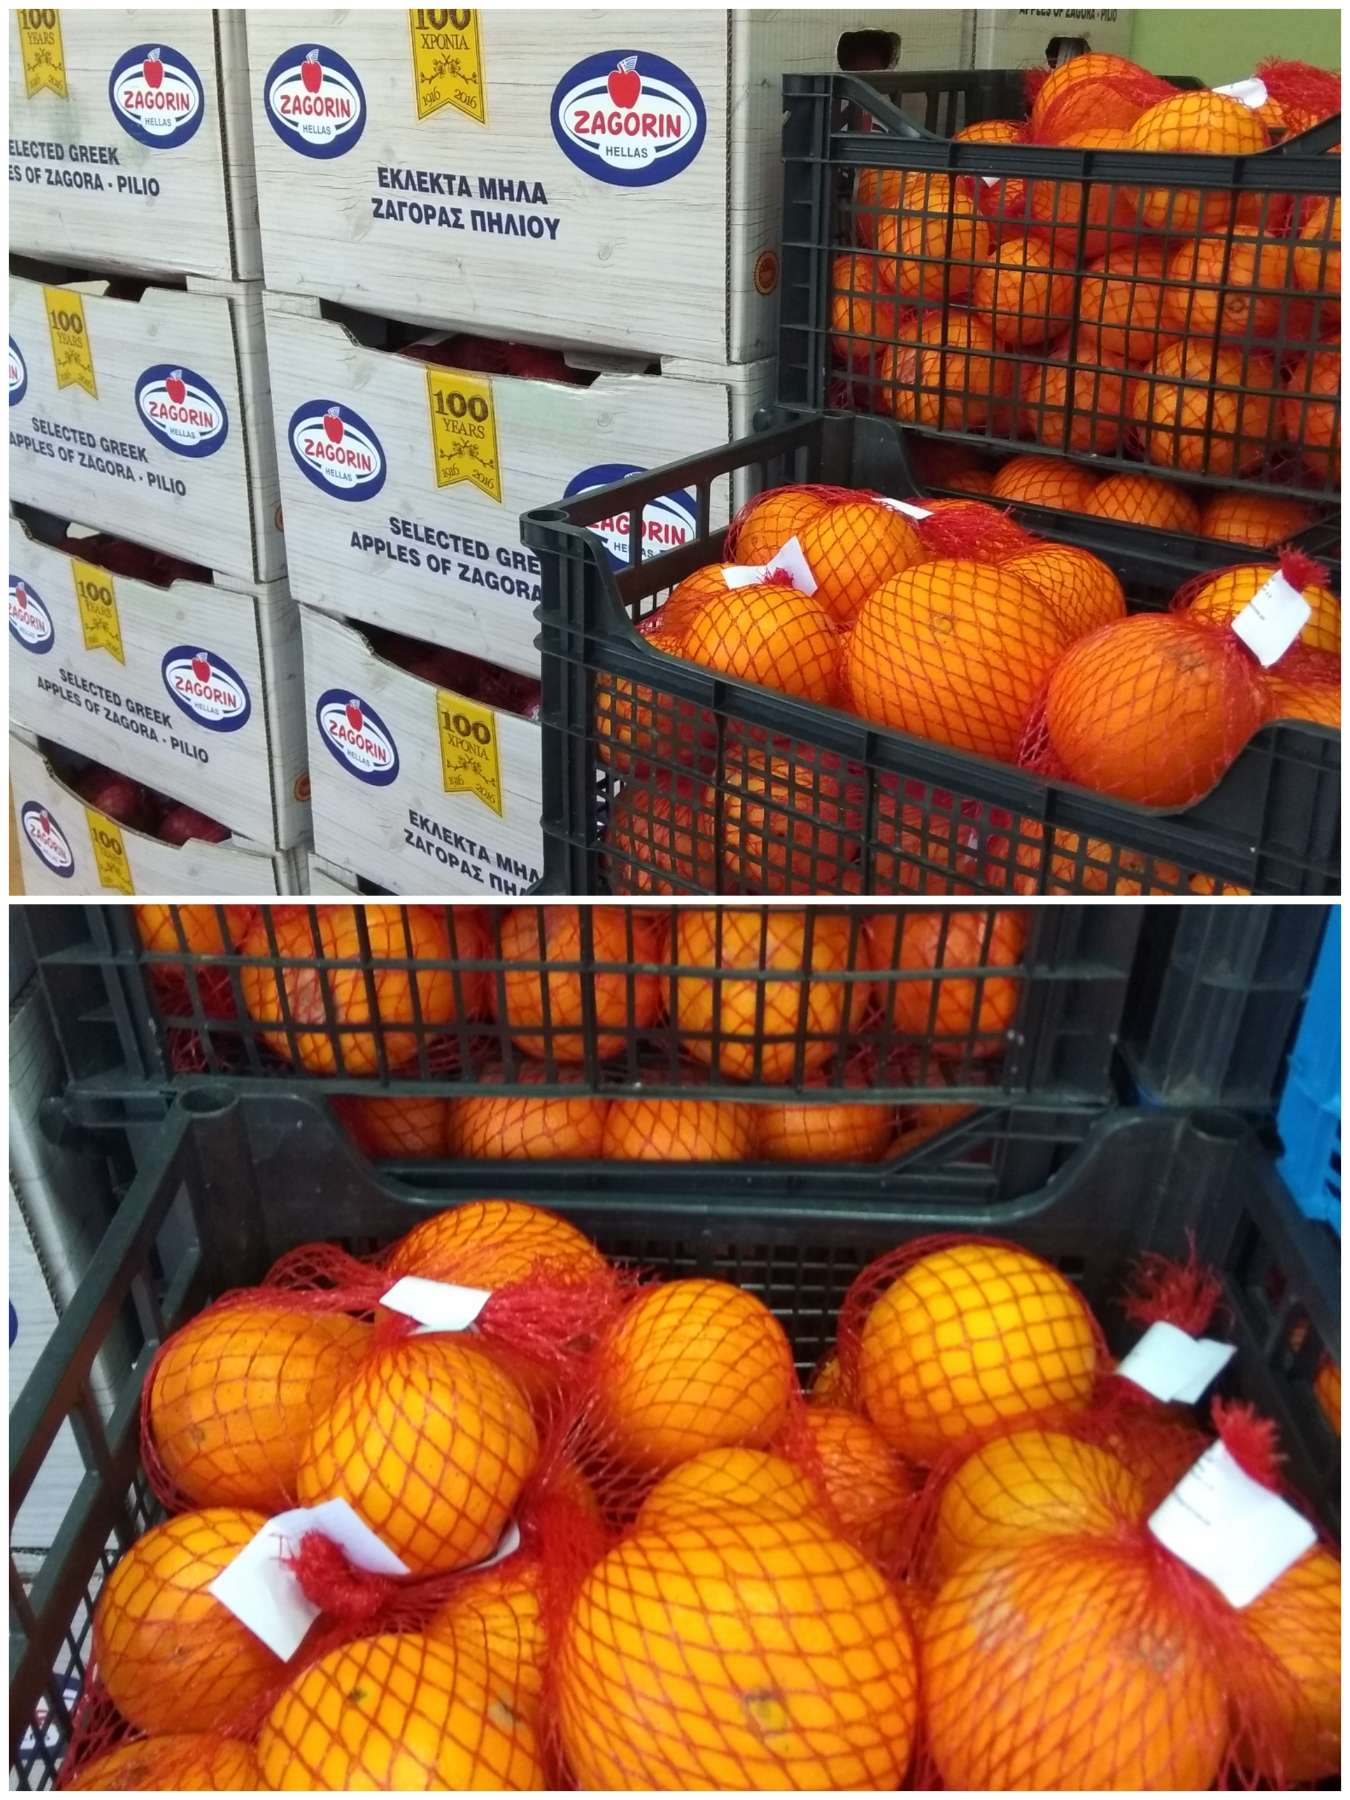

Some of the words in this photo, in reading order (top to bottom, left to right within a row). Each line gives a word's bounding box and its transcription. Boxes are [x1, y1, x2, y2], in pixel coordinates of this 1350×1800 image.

[20, 9, 56, 30] 100
[415, 9, 471, 31] 100
[27, 31, 55, 45] YEARS
[421, 33, 470, 50] ΧΡΟΝΙΑ
[123, 90, 190, 111] ZAGORIN
[280, 95, 351, 118] ZAGORIN
[422, 87, 440, 107] 1916
[453, 88, 477, 108] 2016
[144, 117, 172, 127] HELLAS
[302, 124, 331, 135] HELLAS
[574, 110, 682, 138] ZAGORIN
[9, 139, 65, 160] ELECTED
[69, 144, 120, 165] GREEK
[605, 146, 648, 158] HELLAS
[26, 166, 41, 184] OF
[45, 168, 104, 191] ZAGORA
[117, 175, 160, 197] PILIO
[377, 166, 472, 198] ΕΚΛΕΚΤΑ
[478, 176, 548, 205] ΜΗΛΑ
[371, 197, 465, 230] ΖΑΓΟΡΑΣ
[470, 209, 560, 240] ΠΗΛΙΟΥ
[50, 310, 83, 334] 100
[148, 401, 214, 428] ZAGORIN
[433, 390, 489, 423] 100
[32, 417, 96, 449] SELECTED
[100, 437, 149, 463] GREEK
[442, 417, 486, 439] YEARS
[9, 431, 56, 458] APPLES
[58, 447, 76, 464] OF
[78, 452, 136, 482] ZAGORA
[146, 472, 187, 497] PILIO
[304, 438, 372, 472] ZAGORIN
[325, 467, 353, 482] HELLAS
[471, 467, 495, 490] 2016
[389, 516, 490, 561] SELECTED
[614, 542, 654, 559] HEAS
[350, 531, 421, 567] APPLES
[427, 554, 453, 576] OF
[457, 562, 541, 602] ZAGORA
[78, 580, 112, 606] 100
[59, 668, 121, 706] SELECTED
[125, 698, 173, 729] GREEK
[175, 675, 237, 708] ZAGORIN
[37, 676, 81, 708] APPLES
[84, 697, 101, 715] OF
[104, 708, 158, 743] ZAGORA
[170, 735, 209, 763] PILIO
[441, 711, 491, 745] 100
[329, 720, 387, 763] ZAGORIN
[447, 733, 489, 761] ΧΡΟΝΙΑ
[92, 827, 122, 855] 100
[408, 808, 491, 865] ΕΚΛΕΚΤΑ
[404, 828, 485, 884] ΖΑΓΟΡΑΣ
